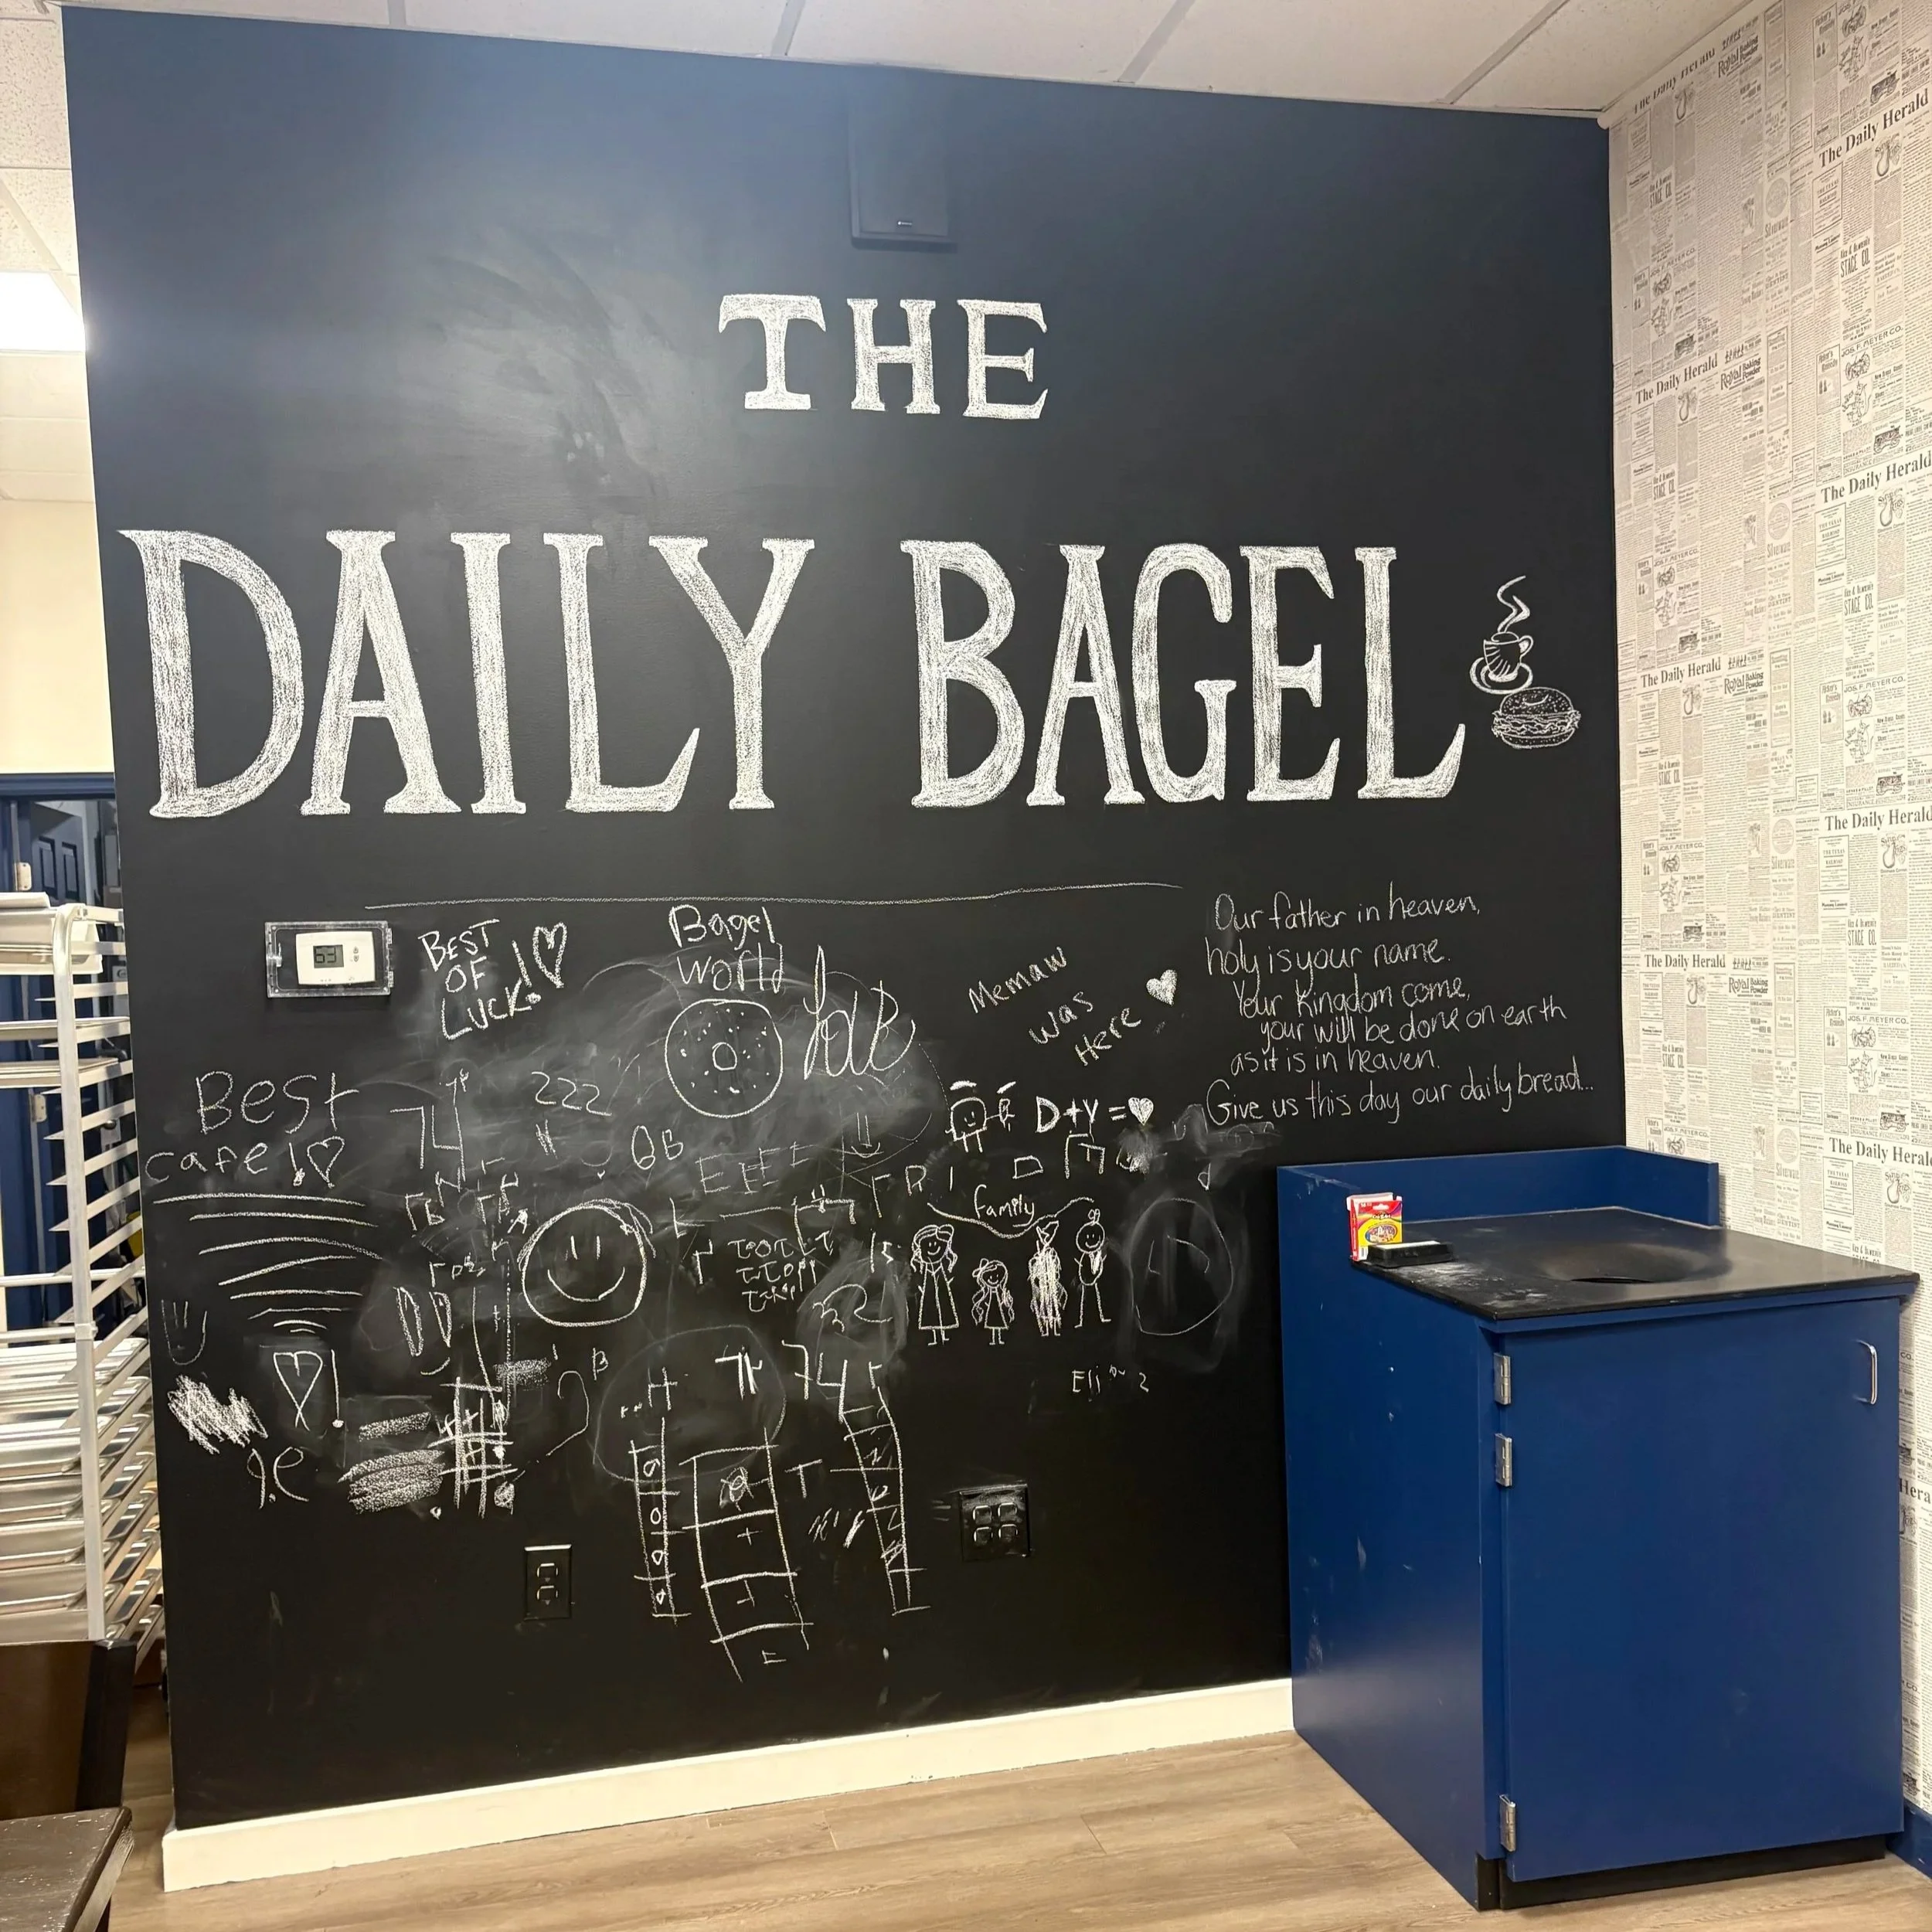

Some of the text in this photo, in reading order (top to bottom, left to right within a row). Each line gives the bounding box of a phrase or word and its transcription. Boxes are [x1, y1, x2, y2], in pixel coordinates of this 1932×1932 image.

[1819, 88, 1928, 168] The Daily Herald
[718, 294, 1049, 420] THE
[1864, 332, 1888, 347] MEYER
[1636, 388, 1654, 405] The
[1656, 373, 1680, 395] Daily
[1683, 353, 1718, 383] Herald
[1721, 366, 1741, 390] Royal
[1821, 451, 1932, 503] The Daily Herald
[116, 529, 1466, 818] DAILY BAGEL
[1641, 674, 1658, 688] The
[1662, 666, 1685, 683] Daily
[1688, 657, 1721, 677] Herald
[1724, 675, 1744, 694] Royal
[1825, 806, 1932, 831] The Daily Herald
[668, 904, 776, 951] Bagel
[1215, 881, 1480, 932] Our father in heaven,
[418, 920, 499, 971] BEST
[1848, 930, 1863, 946] STAGE
[445, 957, 487, 993] OF
[968, 947, 1068, 1012] Memaw
[1205, 937, 1451, 997] holy is your name.
[1645, 954, 1662, 968] The
[1665, 954, 1689, 971] Daily
[1692, 954, 1726, 968] Herald
[1729, 977, 1768, 994] Royal Baking
[1233, 980, 1281, 1019] Your
[1402, 978, 1470, 1007] come,
[1075, 1008, 1141, 1066] Here
[1260, 995, 1567, 1053] your will be done on earth
[1231, 1051, 1257, 1076] as
[1287, 1049, 1306, 1073] is
[1315, 1048, 1337, 1072] in
[1347, 1043, 1439, 1072] heaven.
[196, 1070, 360, 1134] Best
[1206, 1079, 1264, 1125] Give
[1272, 1096, 1299, 1117] us
[1305, 1080, 1351, 1120] this
[1360, 1080, 1400, 1124] day
[1413, 1083, 1451, 1104] our
[1461, 1064, 1512, 1113] daily
[1829, 1138, 1852, 1155] The
[1856, 1141, 1888, 1162] Daily
[1899, 1478, 1932, 1505] Hera
